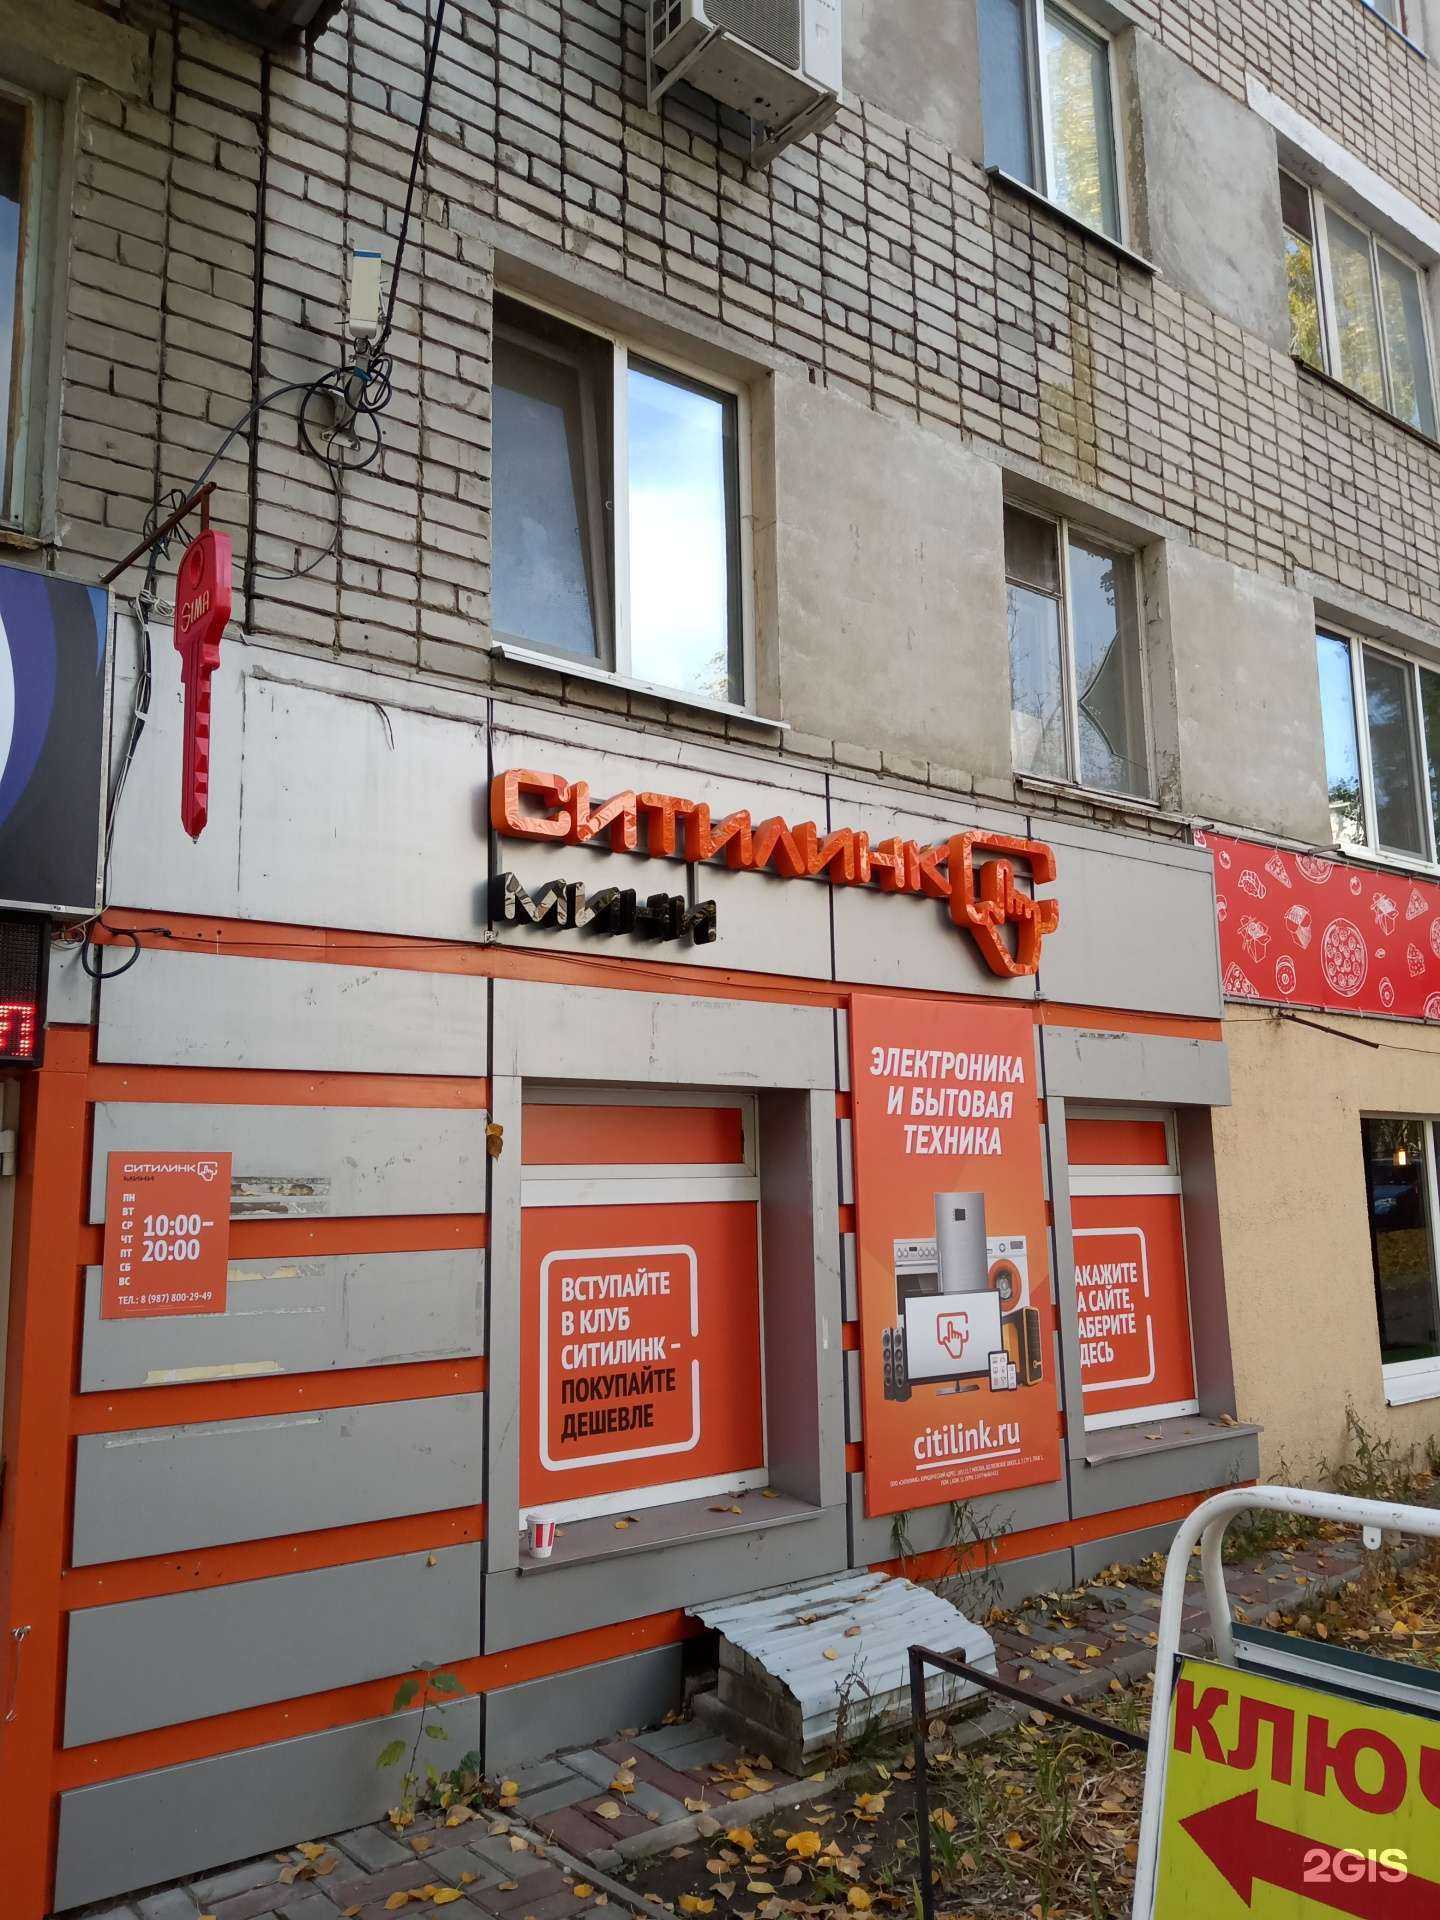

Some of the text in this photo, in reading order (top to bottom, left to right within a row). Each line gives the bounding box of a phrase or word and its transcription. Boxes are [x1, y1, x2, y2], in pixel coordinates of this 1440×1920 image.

[491, 768, 953, 896] СИТИЛИНК
[870, 1046, 1025, 1083] ЭЛЕКТРОНИКА
[887, 1086, 1013, 1118] И БЫТОВАЯ
[904, 1124, 1002, 1155] ТЕХНИКА
[124, 1164, 196, 1173] СИТИЛИНК
[123, 1193, 135, 1202] ПН
[122, 1207, 134, 1216] ВТ
[121, 1221, 133, 1230] СР
[121, 1235, 133, 1244] ЧТ
[142, 1239, 200, 1262] 20:00
[120, 1249, 132, 1258] ПТ
[120, 1263, 131, 1272] СБ
[1074, 1263, 1137, 1286] АКАЖИТЕ
[119, 1277, 130, 1286] ВС
[561, 1268, 670, 1302] ВСТУПАЙТЕ
[141, 1296, 145, 1304] 8
[148, 1294, 169, 1304] (987)
[171, 1292, 212, 1302] 800-29-49
[1089, 1285, 1134, 1311] САЙТЕ,
[561, 1306, 630, 1336] В КЛУБ
[1078, 1313, 1136, 1338] АБЕРИТЕ
[561, 1336, 666, 1369] СИТИЛИНК
[1080, 1342, 1114, 1368] ДЕСЬ
[561, 1366, 676, 1404] ПОКУПАЙТЕ
[561, 1404, 654, 1443] ДЕШЕВЛЕ
[913, 1420, 1020, 1459] citilink.ru
